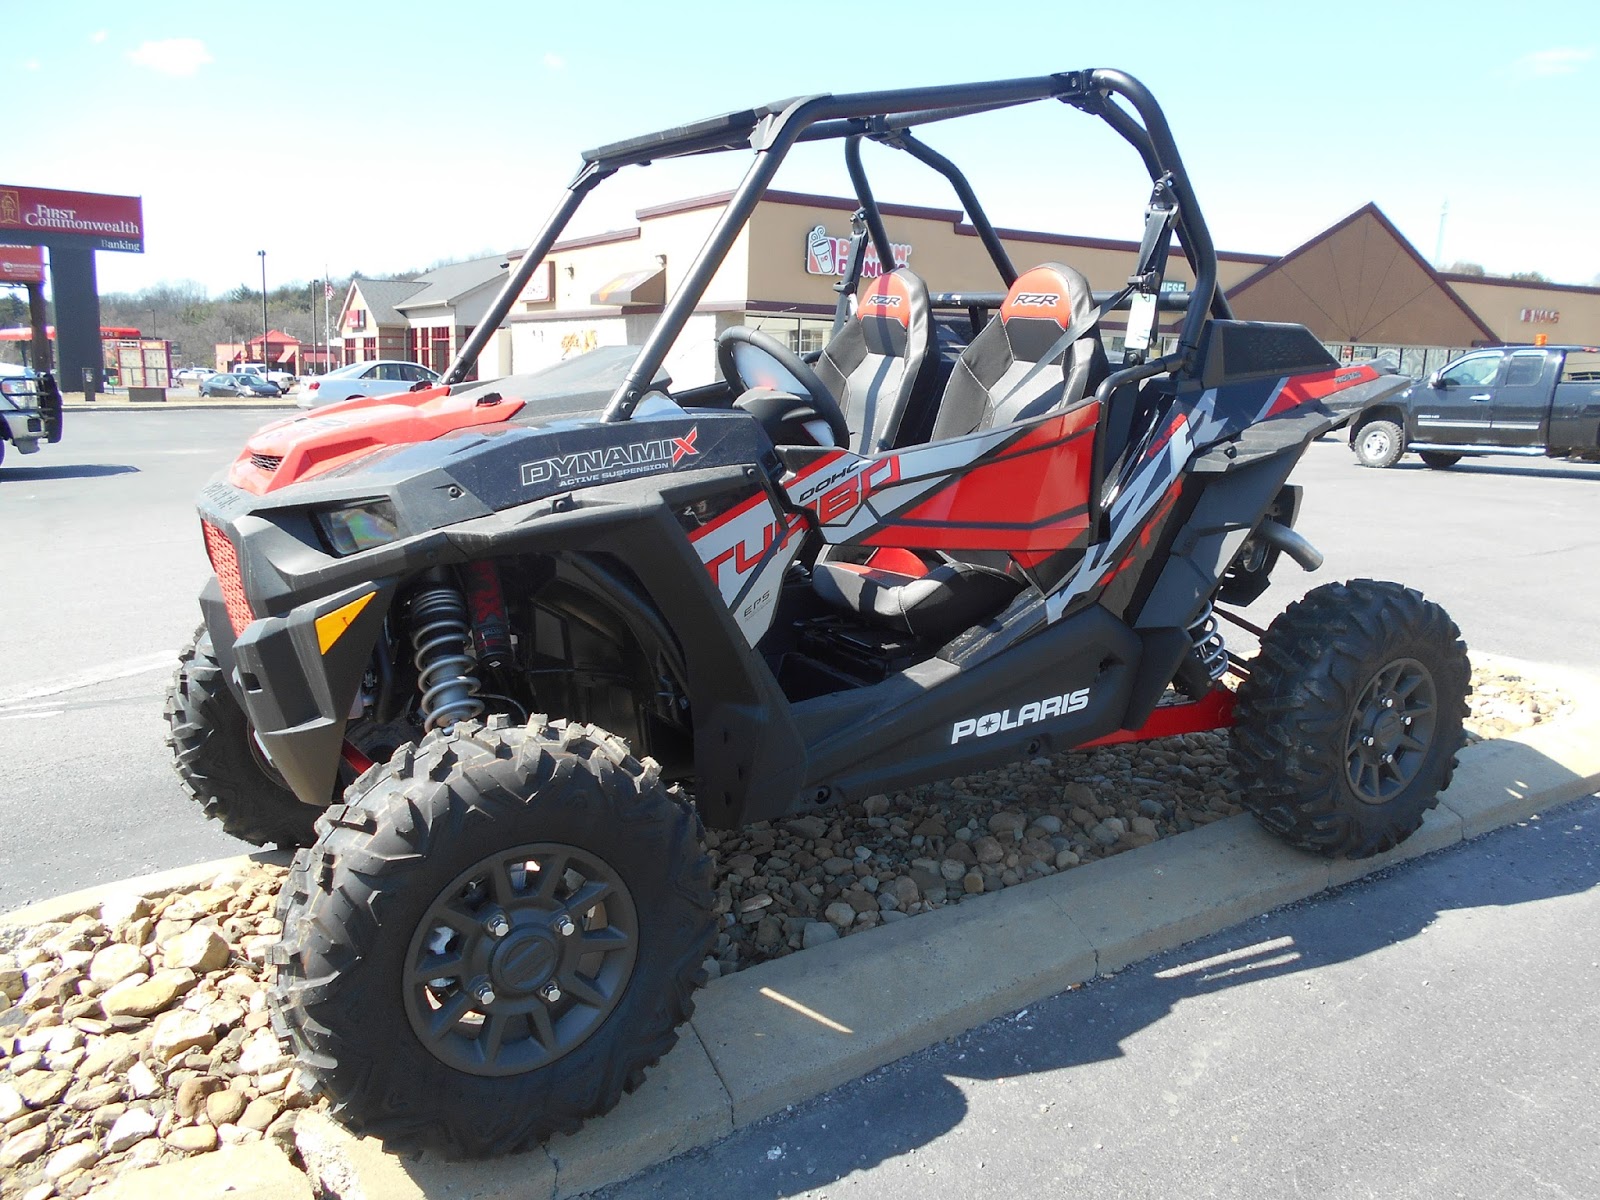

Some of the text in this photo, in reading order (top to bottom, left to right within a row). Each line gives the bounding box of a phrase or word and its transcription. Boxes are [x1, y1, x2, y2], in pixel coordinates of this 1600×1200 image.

[26, 213, 139, 234] Commonwealth
[37, 204, 76, 220] FIRST
[101, 239, 140, 251] Banking
[867, 295, 901, 306] RZR
[1011, 293, 1060, 307] RZR
[521, 425, 699, 486] DYNAMIX
[558, 462, 669, 487] ACTIVE SUSPENSION
[798, 460, 859, 503] DOHC
[743, 590, 770, 618] EPS
[951, 687, 1091, 745] POLARIS
